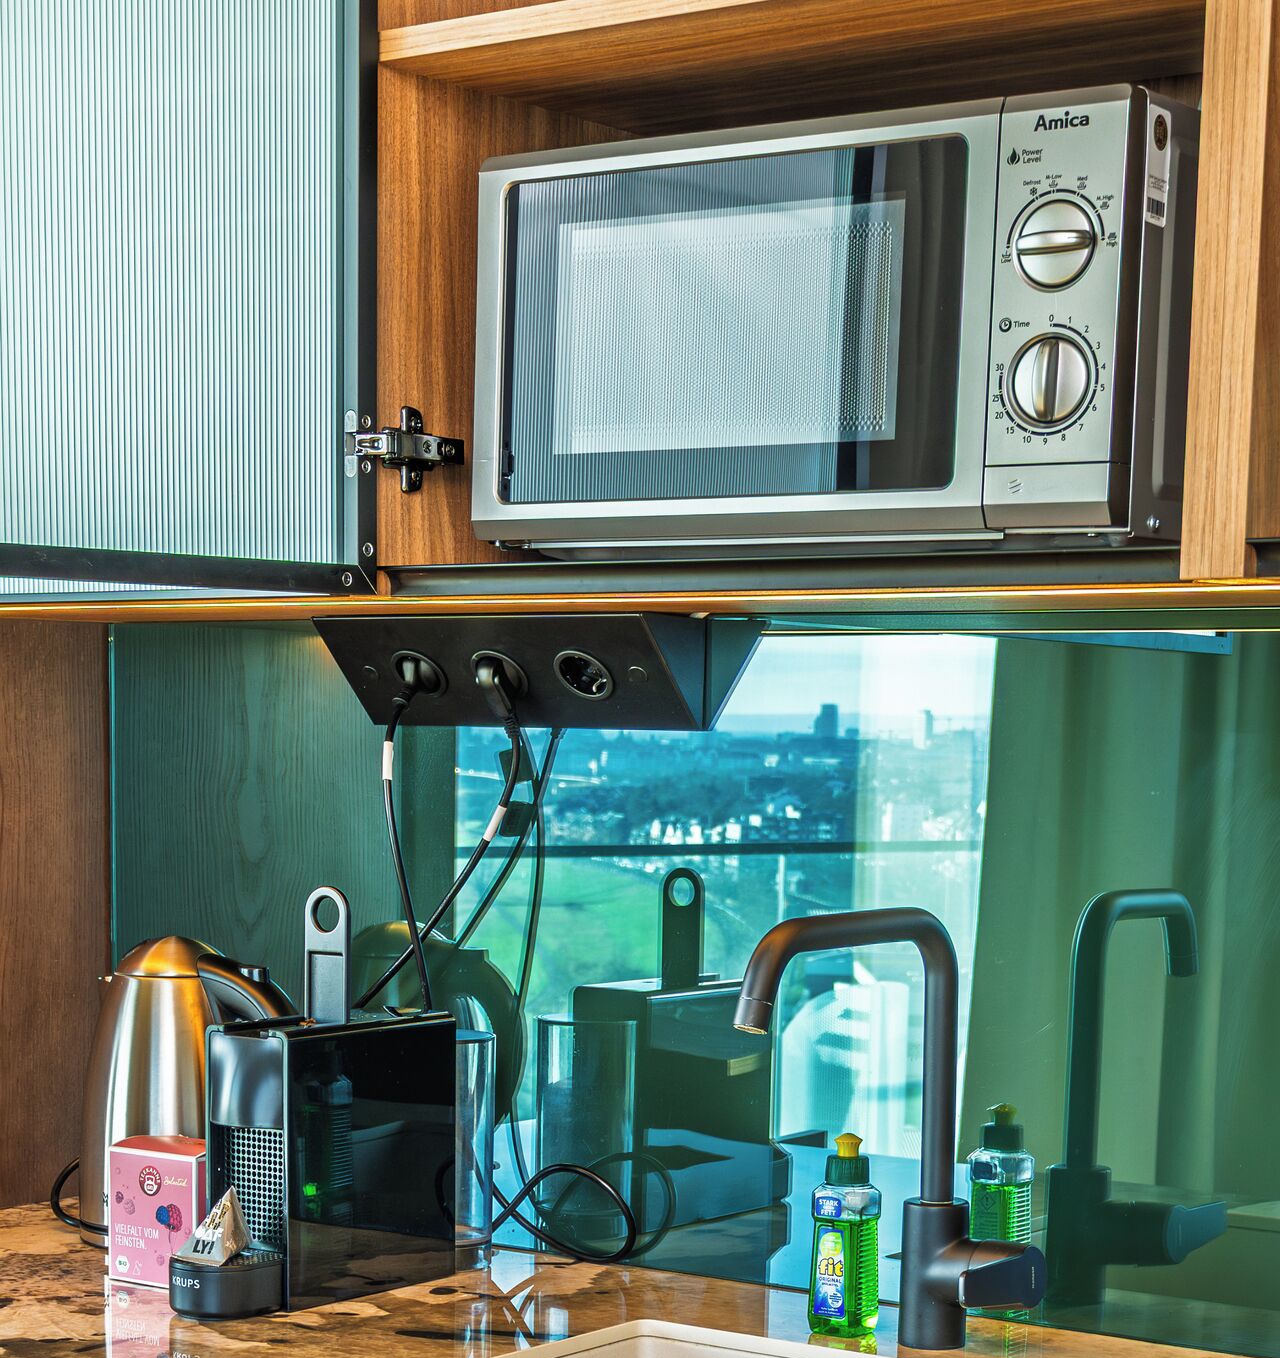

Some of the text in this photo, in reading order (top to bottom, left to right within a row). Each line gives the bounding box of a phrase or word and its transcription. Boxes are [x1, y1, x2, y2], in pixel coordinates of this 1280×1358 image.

[1033, 110, 1090, 132] Amica
[1021, 148, 1043, 157] Power
[1022, 156, 1042, 164] Level
[1106, 240, 1118, 248] High
[1013, 320, 1031, 329] Time
[995, 363, 1004, 372] 30
[992, 394, 1000, 402] 25
[994, 411, 1004, 420] 20
[1006, 426, 1015, 434] 15
[1022, 435, 1032, 444] 10
[818, 1199, 839, 1207] STARK
[820, 1208, 837, 1216] FETT
[114, 1223, 159, 1239] VIELFALT VOM
[115, 1235, 147, 1250] FEINSTEN.
[192, 1240, 215, 1255] LY!
[818, 1257, 843, 1277] fit
[172, 1275, 200, 1289] KRUPS
[818, 1276, 842, 1284] ORIGINAL
